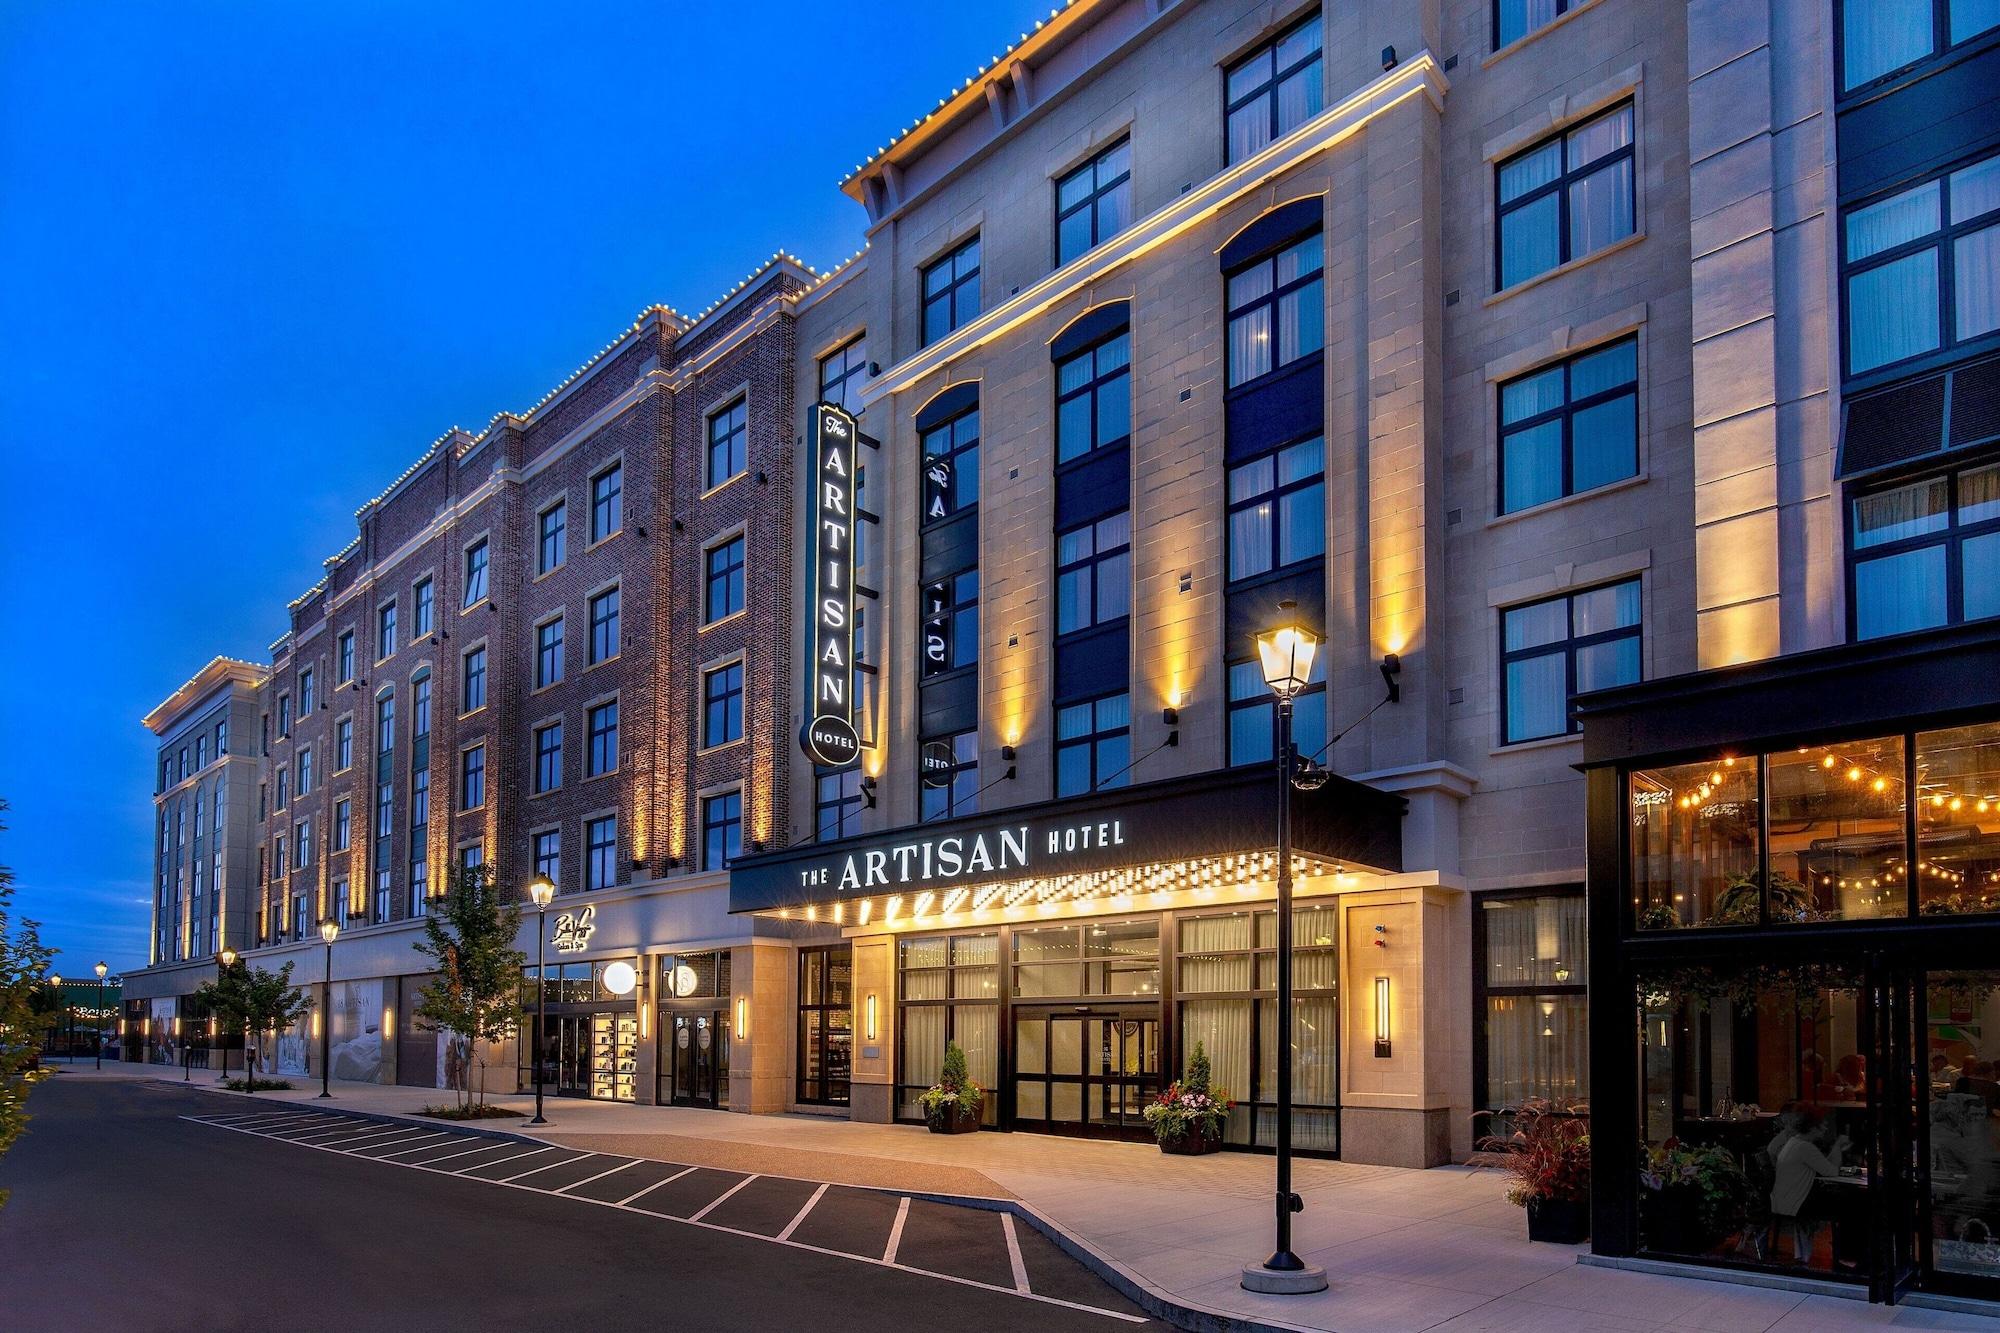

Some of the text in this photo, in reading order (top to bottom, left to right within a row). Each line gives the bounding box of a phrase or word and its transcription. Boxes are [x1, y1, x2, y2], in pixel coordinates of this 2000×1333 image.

[825, 415, 847, 437] The
[822, 447, 846, 704] ARTISAN
[815, 731, 854, 749] HOTEL
[801, 821, 1124, 890] THE ARTISAN HOTEL
